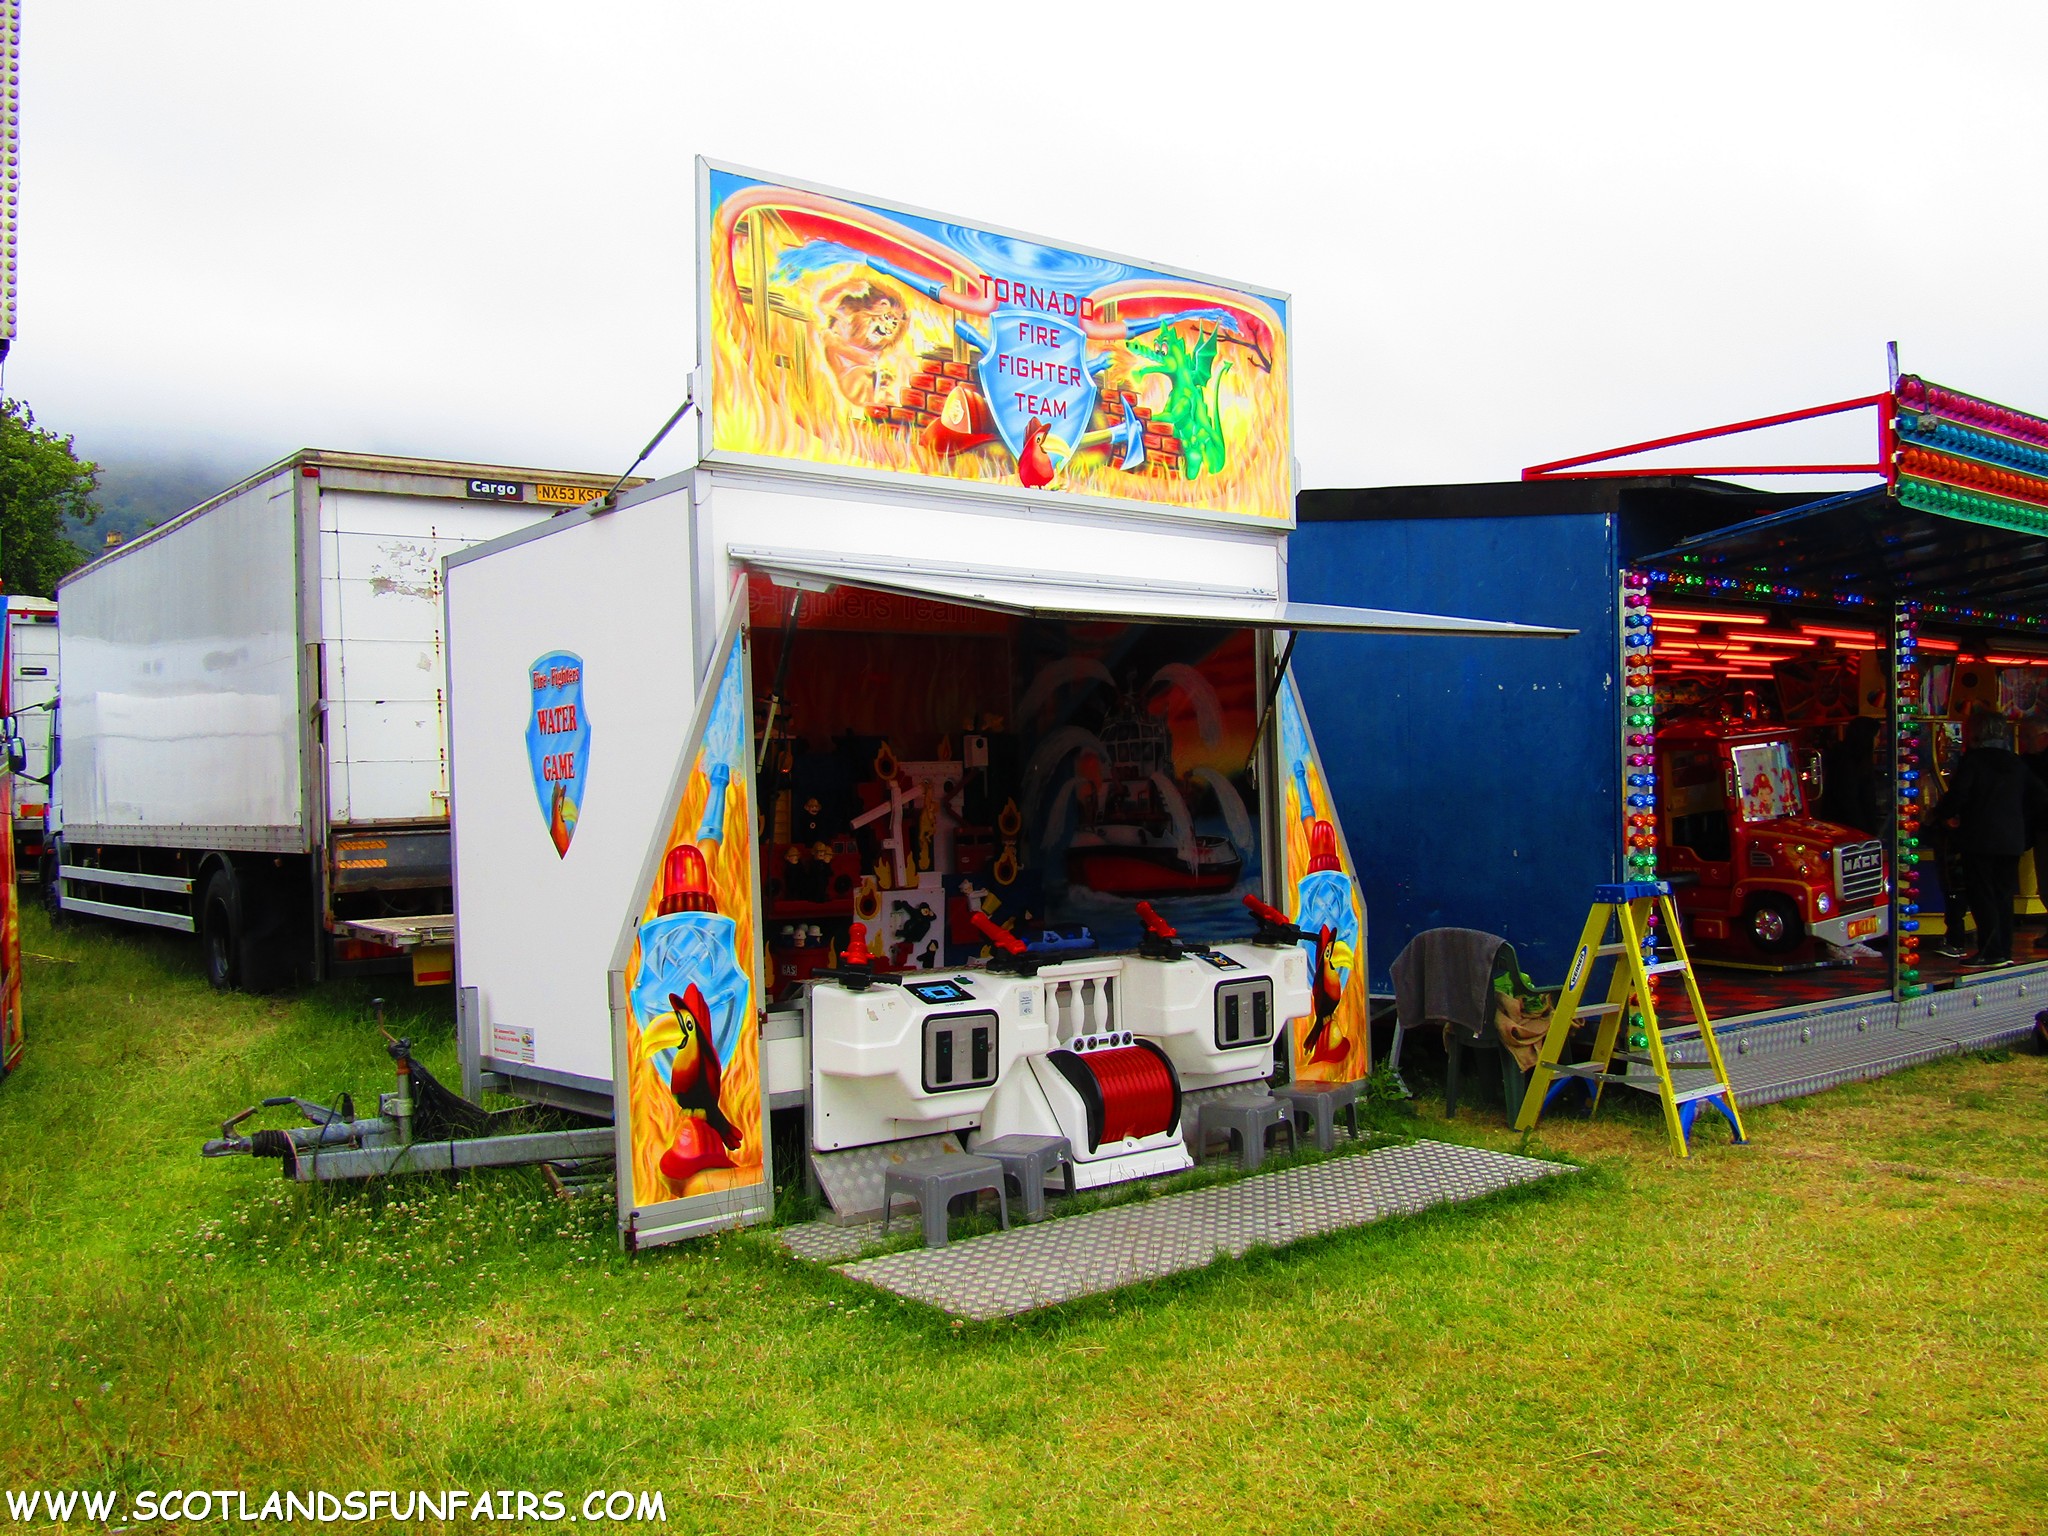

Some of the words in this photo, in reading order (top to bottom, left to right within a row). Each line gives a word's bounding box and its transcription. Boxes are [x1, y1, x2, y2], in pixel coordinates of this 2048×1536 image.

[979, 274, 1094, 321] TORNADO
[1019, 322, 1061, 349] FIRE
[998, 354, 1082, 388] FIGHTER
[1014, 392, 1068, 420] TEAM
[471, 480, 517, 496] Cargo
[542, 486, 575, 501] NX53
[537, 703, 577, 735] WATER
[543, 752, 575, 781] GAME
[1843, 854, 1880, 873] MACK
